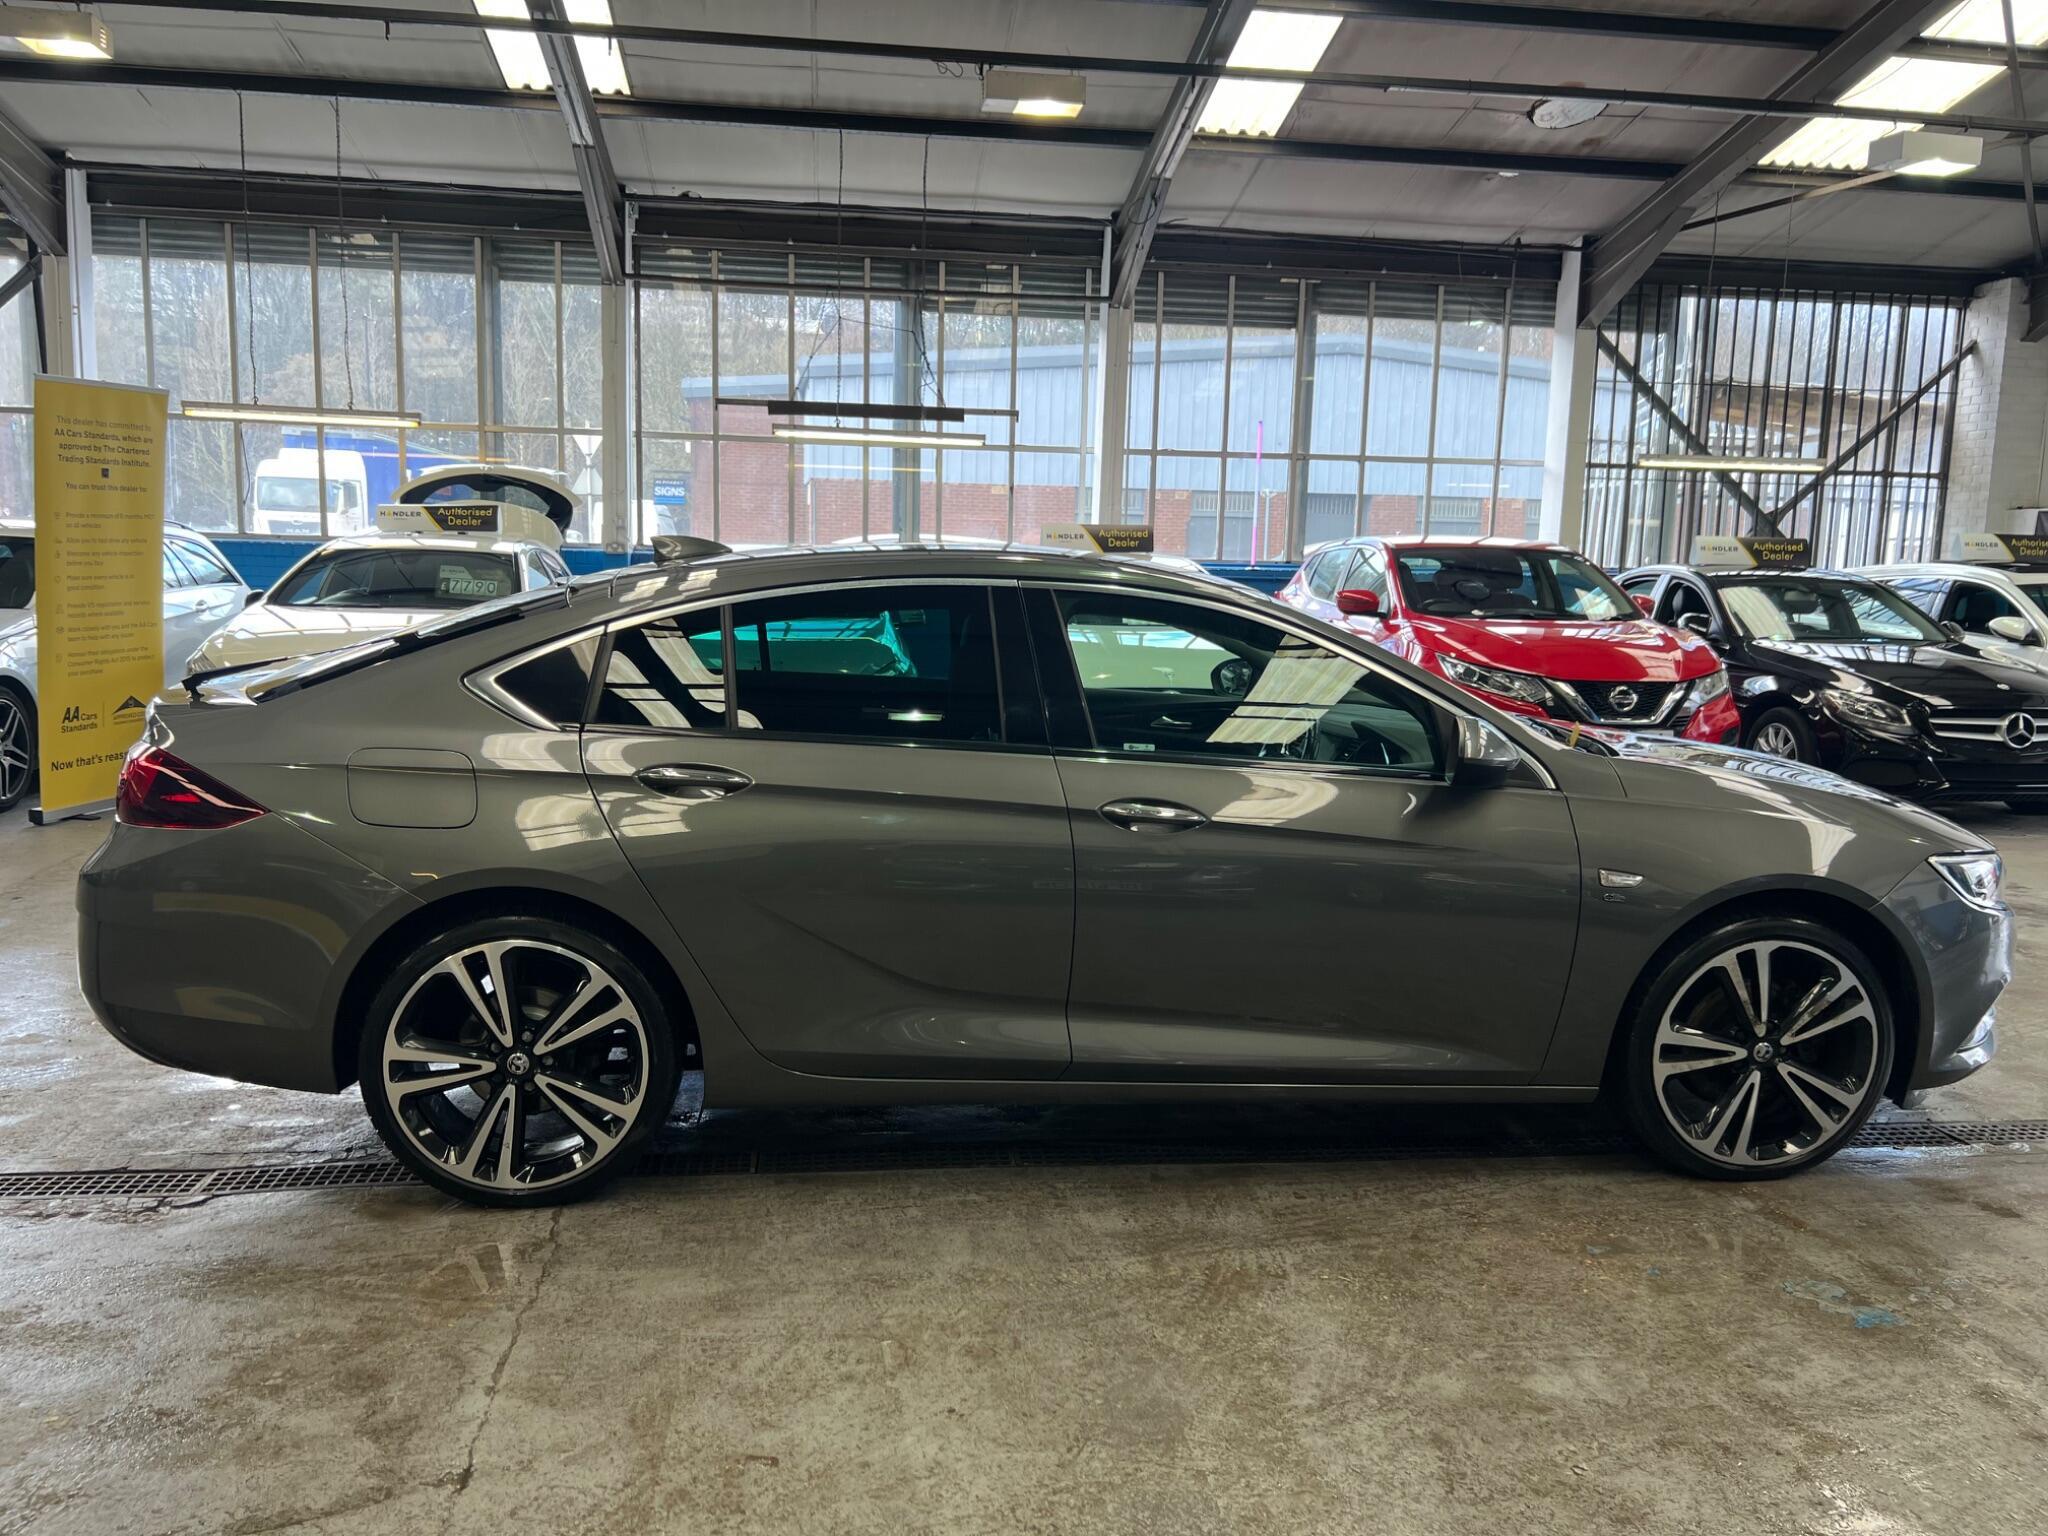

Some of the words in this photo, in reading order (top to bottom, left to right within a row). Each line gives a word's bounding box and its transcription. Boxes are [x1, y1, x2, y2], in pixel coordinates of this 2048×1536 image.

[54, 428, 65, 436] AA
[66, 429, 82, 438] Cars
[59, 443, 92, 452] approved
[117, 446, 150, 456] Chartered
[57, 454, 84, 464] Trading
[654, 486, 685, 496] SIGNS
[437, 507, 493, 516] Authorised
[448, 516, 482, 526] Dealer
[1099, 529, 1149, 538] Authorised
[1108, 538, 1140, 548] Dealer
[1752, 542, 1804, 552] Authorised
[1762, 551, 1794, 561] Dealer
[62, 706, 80, 724] AA
[80, 713, 98, 721] Cars
[61, 722, 98, 734] Standards
[51, 760, 74, 772] Now
[76, 753, 103, 768] that's
